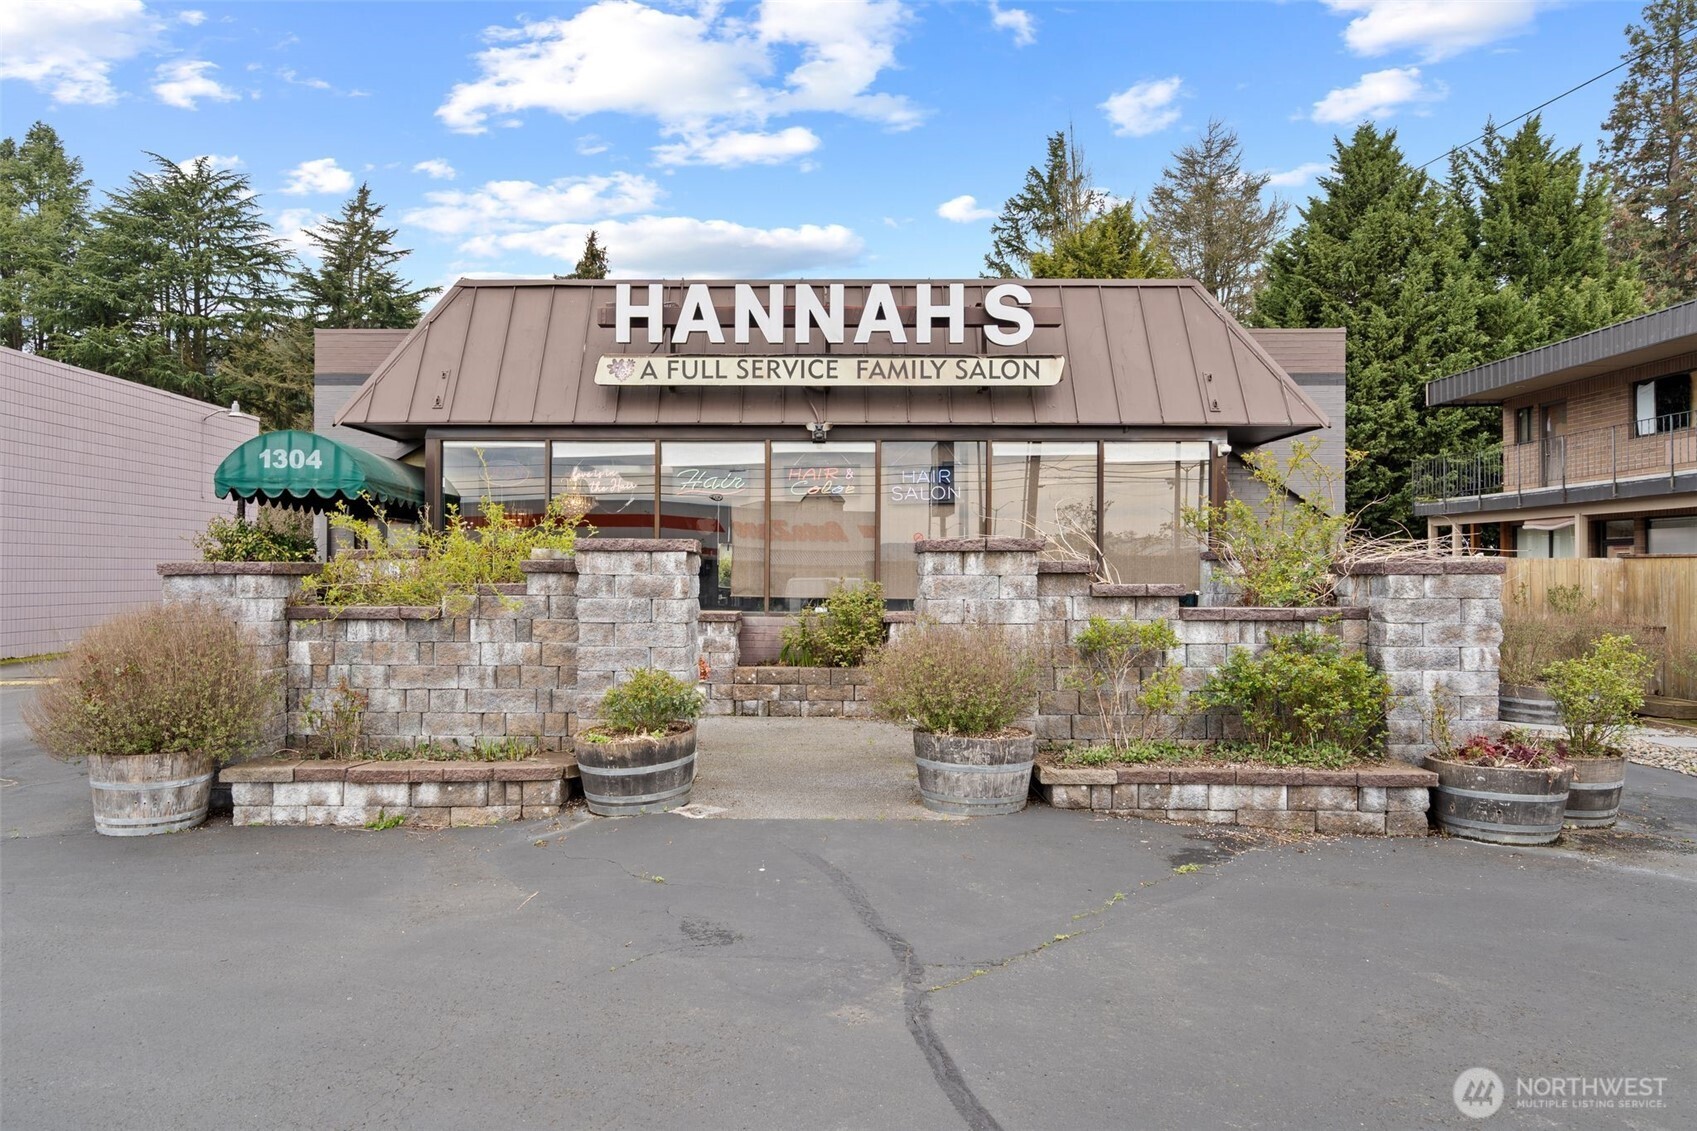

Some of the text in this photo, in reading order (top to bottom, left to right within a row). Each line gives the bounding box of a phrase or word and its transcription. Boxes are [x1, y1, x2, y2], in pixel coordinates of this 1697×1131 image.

[615, 283, 1035, 346] HANNAHS
[640, 358, 1040, 380] A FULL SERVICE FAMILY SALON
[259, 449, 322, 469] 1304
[677, 468, 745, 490] Hair
[788, 467, 855, 481] HAIR &
[902, 469, 951, 483] HAIR
[891, 486, 961, 501] SALON
